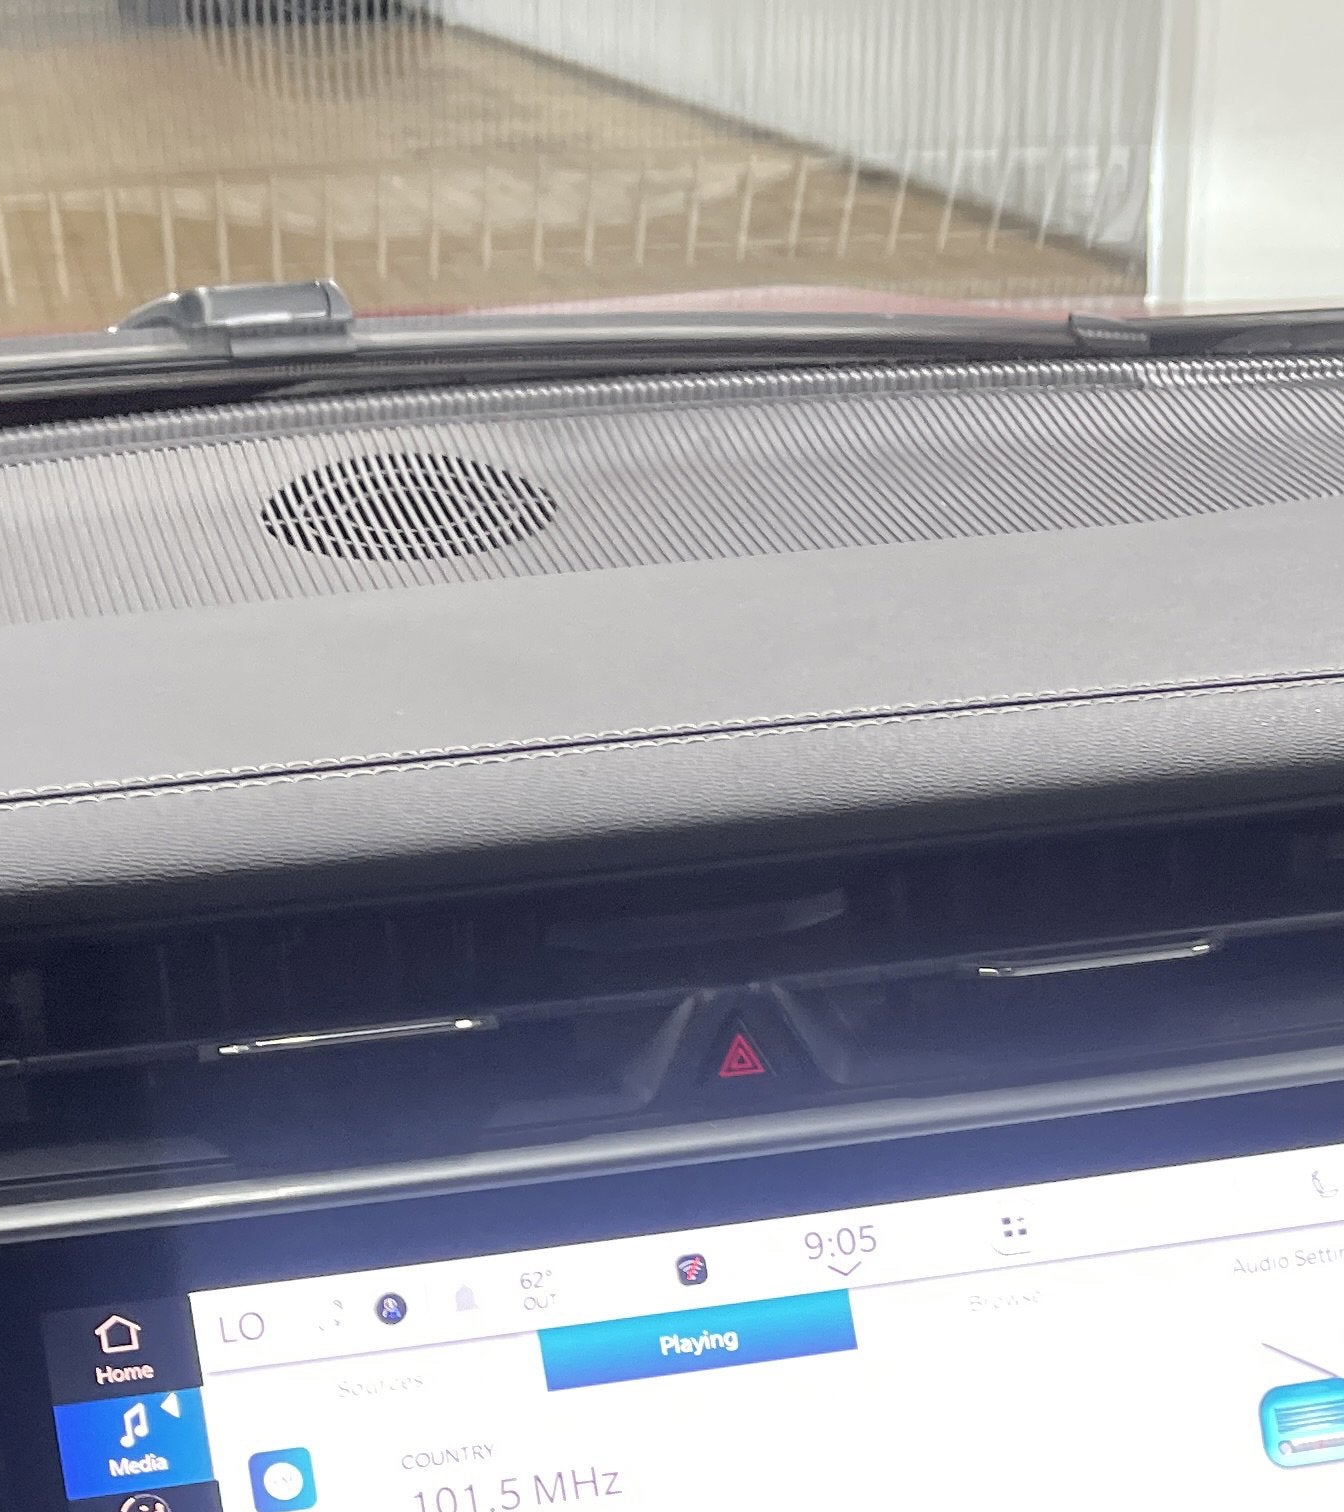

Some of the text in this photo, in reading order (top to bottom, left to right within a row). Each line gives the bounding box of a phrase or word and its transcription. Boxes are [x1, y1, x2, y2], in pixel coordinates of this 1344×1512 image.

[803, 1224, 878, 1262] 9:05
[1233, 1257, 1289, 1274] Audio
[523, 1293, 556, 1311] OUT
[218, 1312, 265, 1343] LO
[661, 1328, 739, 1357] Playing
[95, 1361, 154, 1385] Home
[109, 1453, 168, 1476] Media
[401, 1444, 494, 1470] COUNTRY
[534, 1467, 624, 1504] MHz
